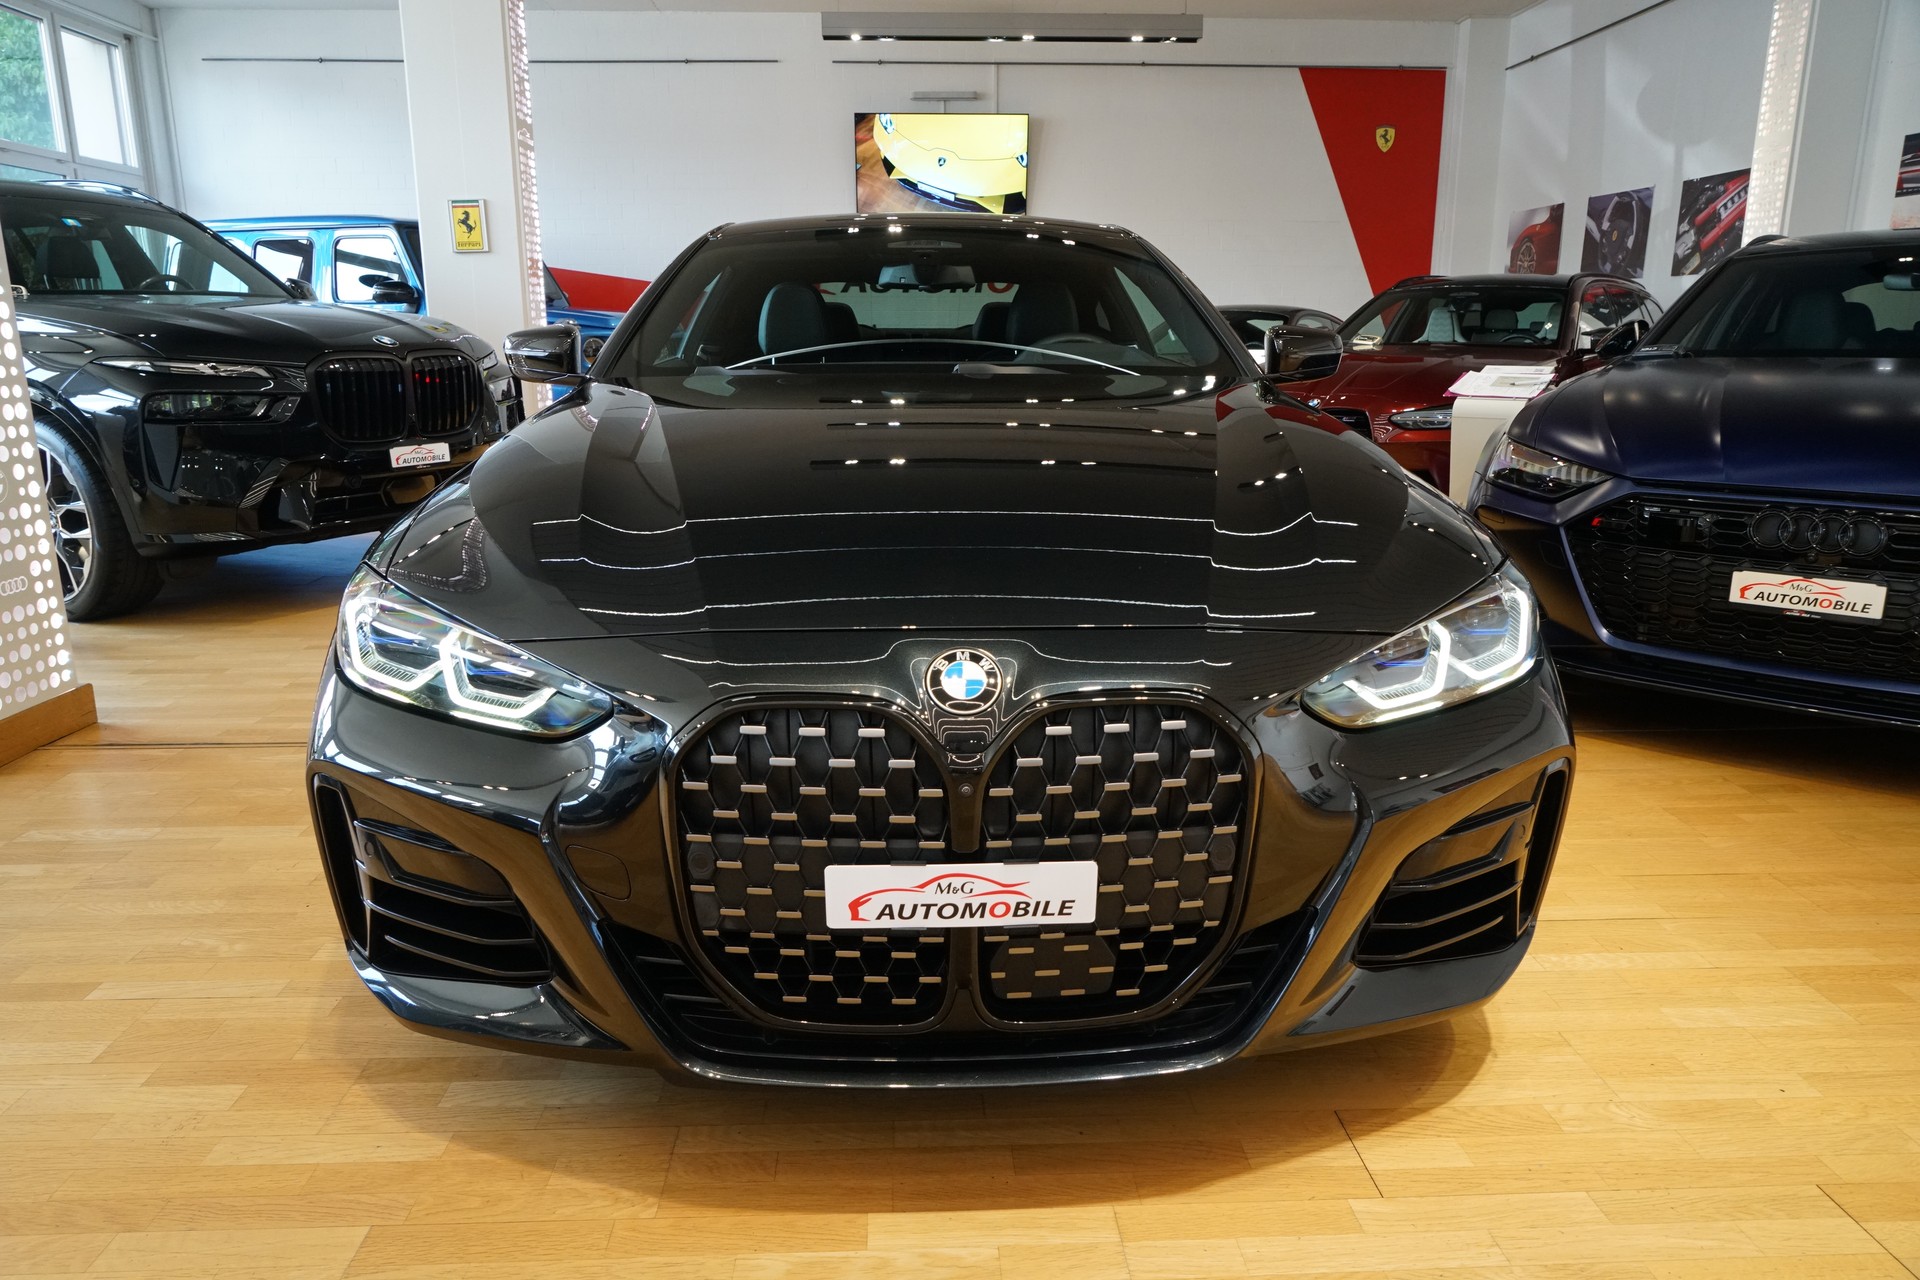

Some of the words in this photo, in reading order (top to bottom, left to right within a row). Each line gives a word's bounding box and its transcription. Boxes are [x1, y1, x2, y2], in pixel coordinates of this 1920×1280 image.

[402, 454, 446, 465] AUTOMOBILE
[1789, 583, 1814, 593] M&G
[1754, 591, 1873, 614] AUTOMOBILE
[935, 651, 995, 671] BMW
[934, 881, 975, 896] M&G
[875, 899, 1076, 921] AUTOMOBILE
